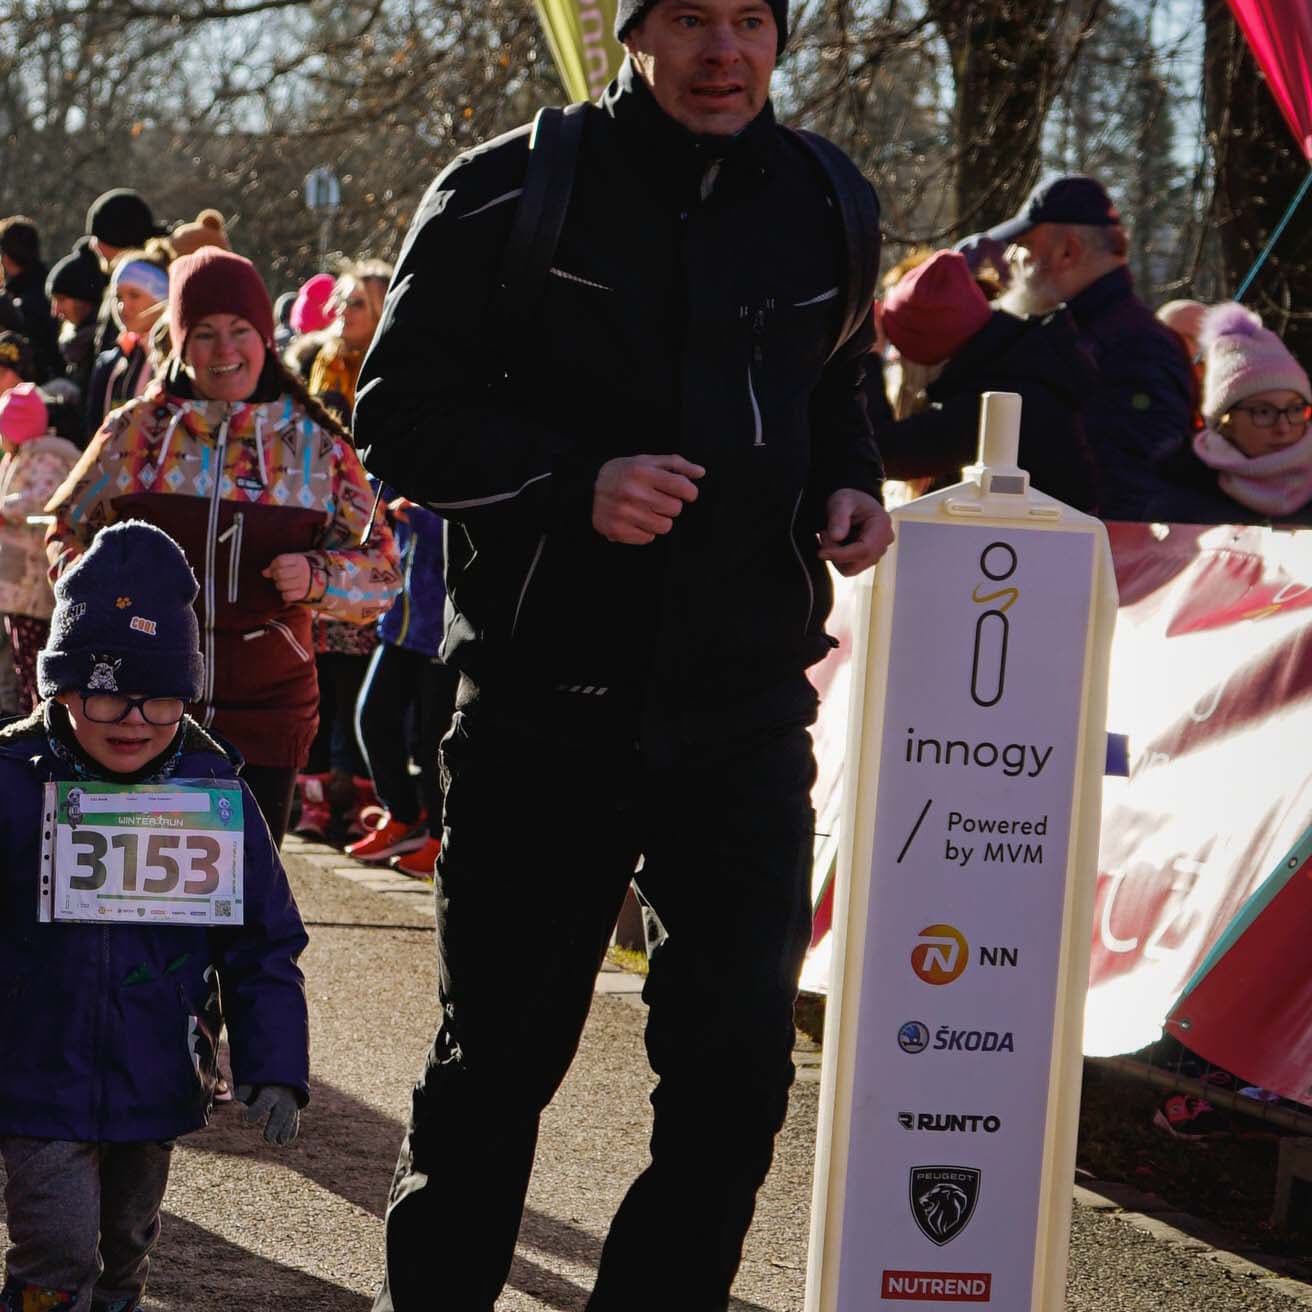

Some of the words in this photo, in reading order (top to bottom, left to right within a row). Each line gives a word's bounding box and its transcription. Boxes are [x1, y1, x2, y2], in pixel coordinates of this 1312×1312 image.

[906, 727, 1054, 777] innogy
[948, 811, 1048, 836] Powered
[70, 830, 221, 895] 3153
[945, 839, 973, 867] by
[983, 843, 1044, 865] MVM
[979, 946, 1019, 968] NN
[933, 1025, 1015, 1053] ŠKODA
[917, 1113, 1001, 1133] RUNTO
[917, 1173, 975, 1181] PEUGEOT
[888, 1277, 986, 1295] NUTREND
